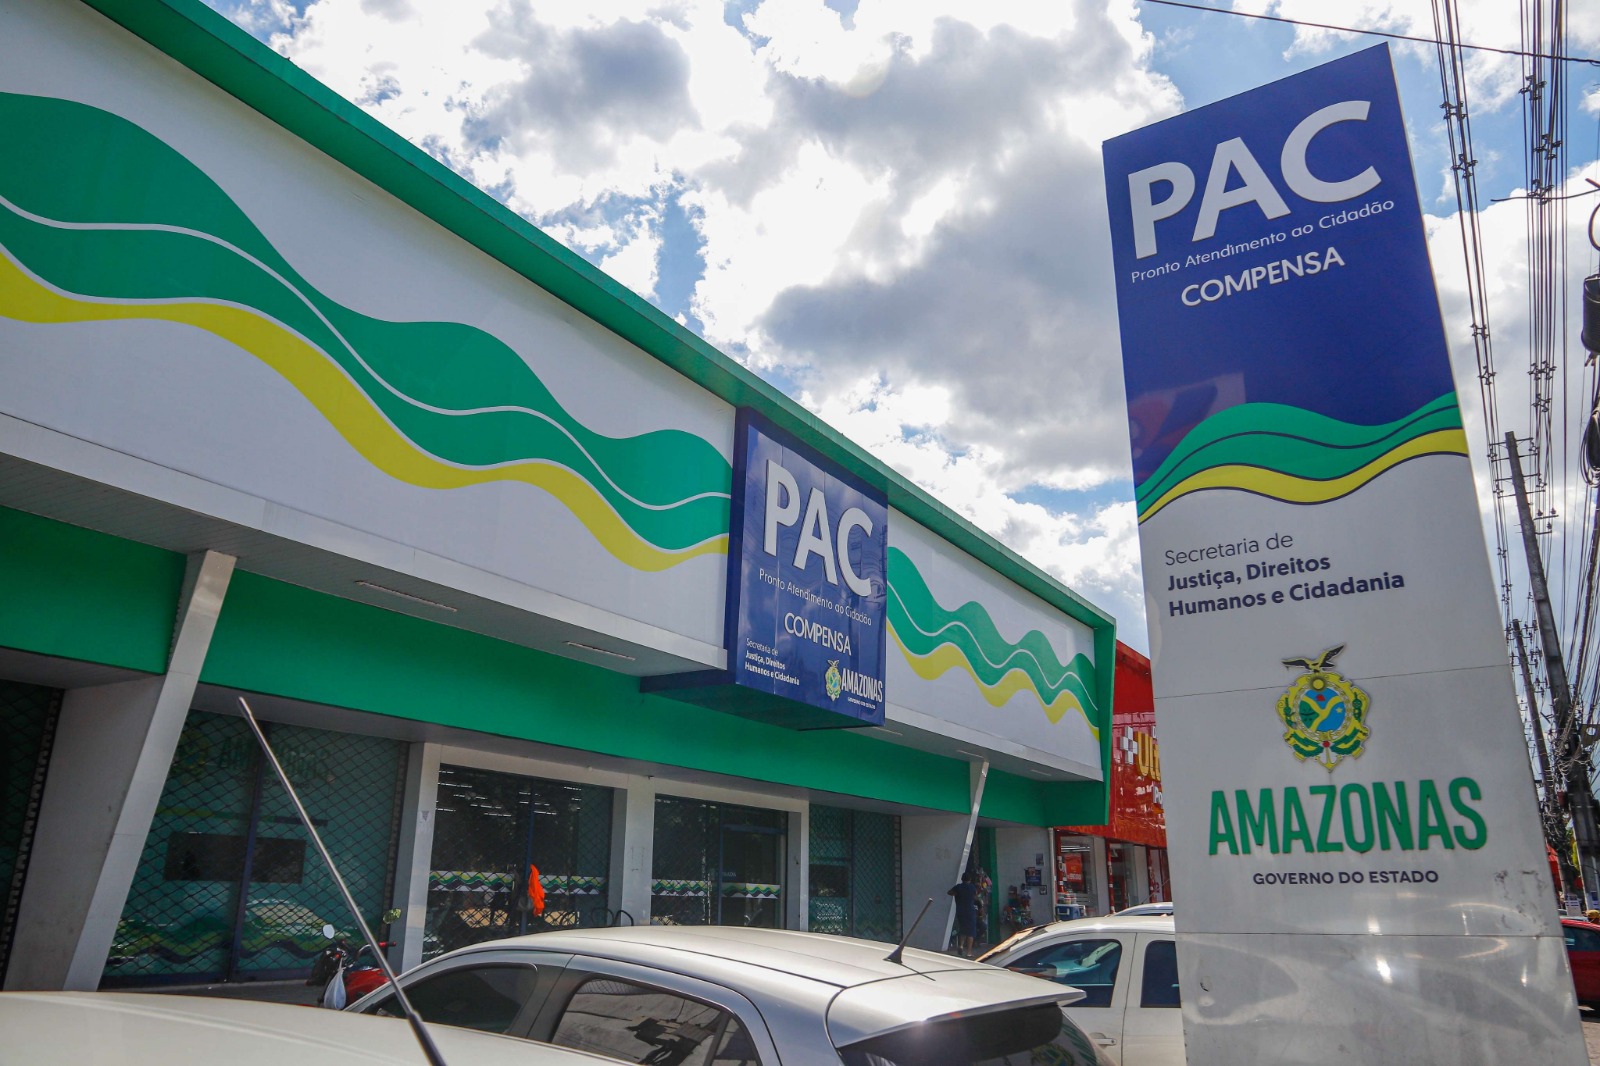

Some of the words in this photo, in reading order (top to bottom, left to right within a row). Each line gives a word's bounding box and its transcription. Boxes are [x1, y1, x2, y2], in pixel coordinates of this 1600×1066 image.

[1128, 100, 1382, 260] PAC
[1131, 260, 1180, 284] Pronto
[1185, 231, 1286, 268] Atendimento
[1291, 223, 1314, 238] ao
[1319, 198, 1395, 230] Cidadão
[1181, 246, 1345, 307] COMPENSA
[763, 459, 874, 597] PAC
[1165, 537, 1260, 567] Secretaria
[1265, 533, 1294, 549] de
[1168, 567, 1242, 591] Justiça,
[1246, 554, 1331, 581] Direitos
[1169, 590, 1267, 617] Humanos
[1271, 588, 1285, 604] e
[1289, 571, 1405, 602] Cidadania
[759, 568, 785, 590] Pronto
[787, 581, 833, 610] Atendimento
[835, 602, 845, 614] ao
[846, 603, 872, 626] Cidadão
[784, 612, 852, 656] COMPENSA
[745, 662, 770, 677] Humanos
[774, 671, 800, 686] Cidadania
[841, 668, 883, 703] AMAZONAS
[1209, 777, 1488, 856] AMAZONAS
[1253, 871, 1334, 885] GOVERNO
[1339, 871, 1365, 885] DO
[1369, 870, 1439, 884] ESTADO
